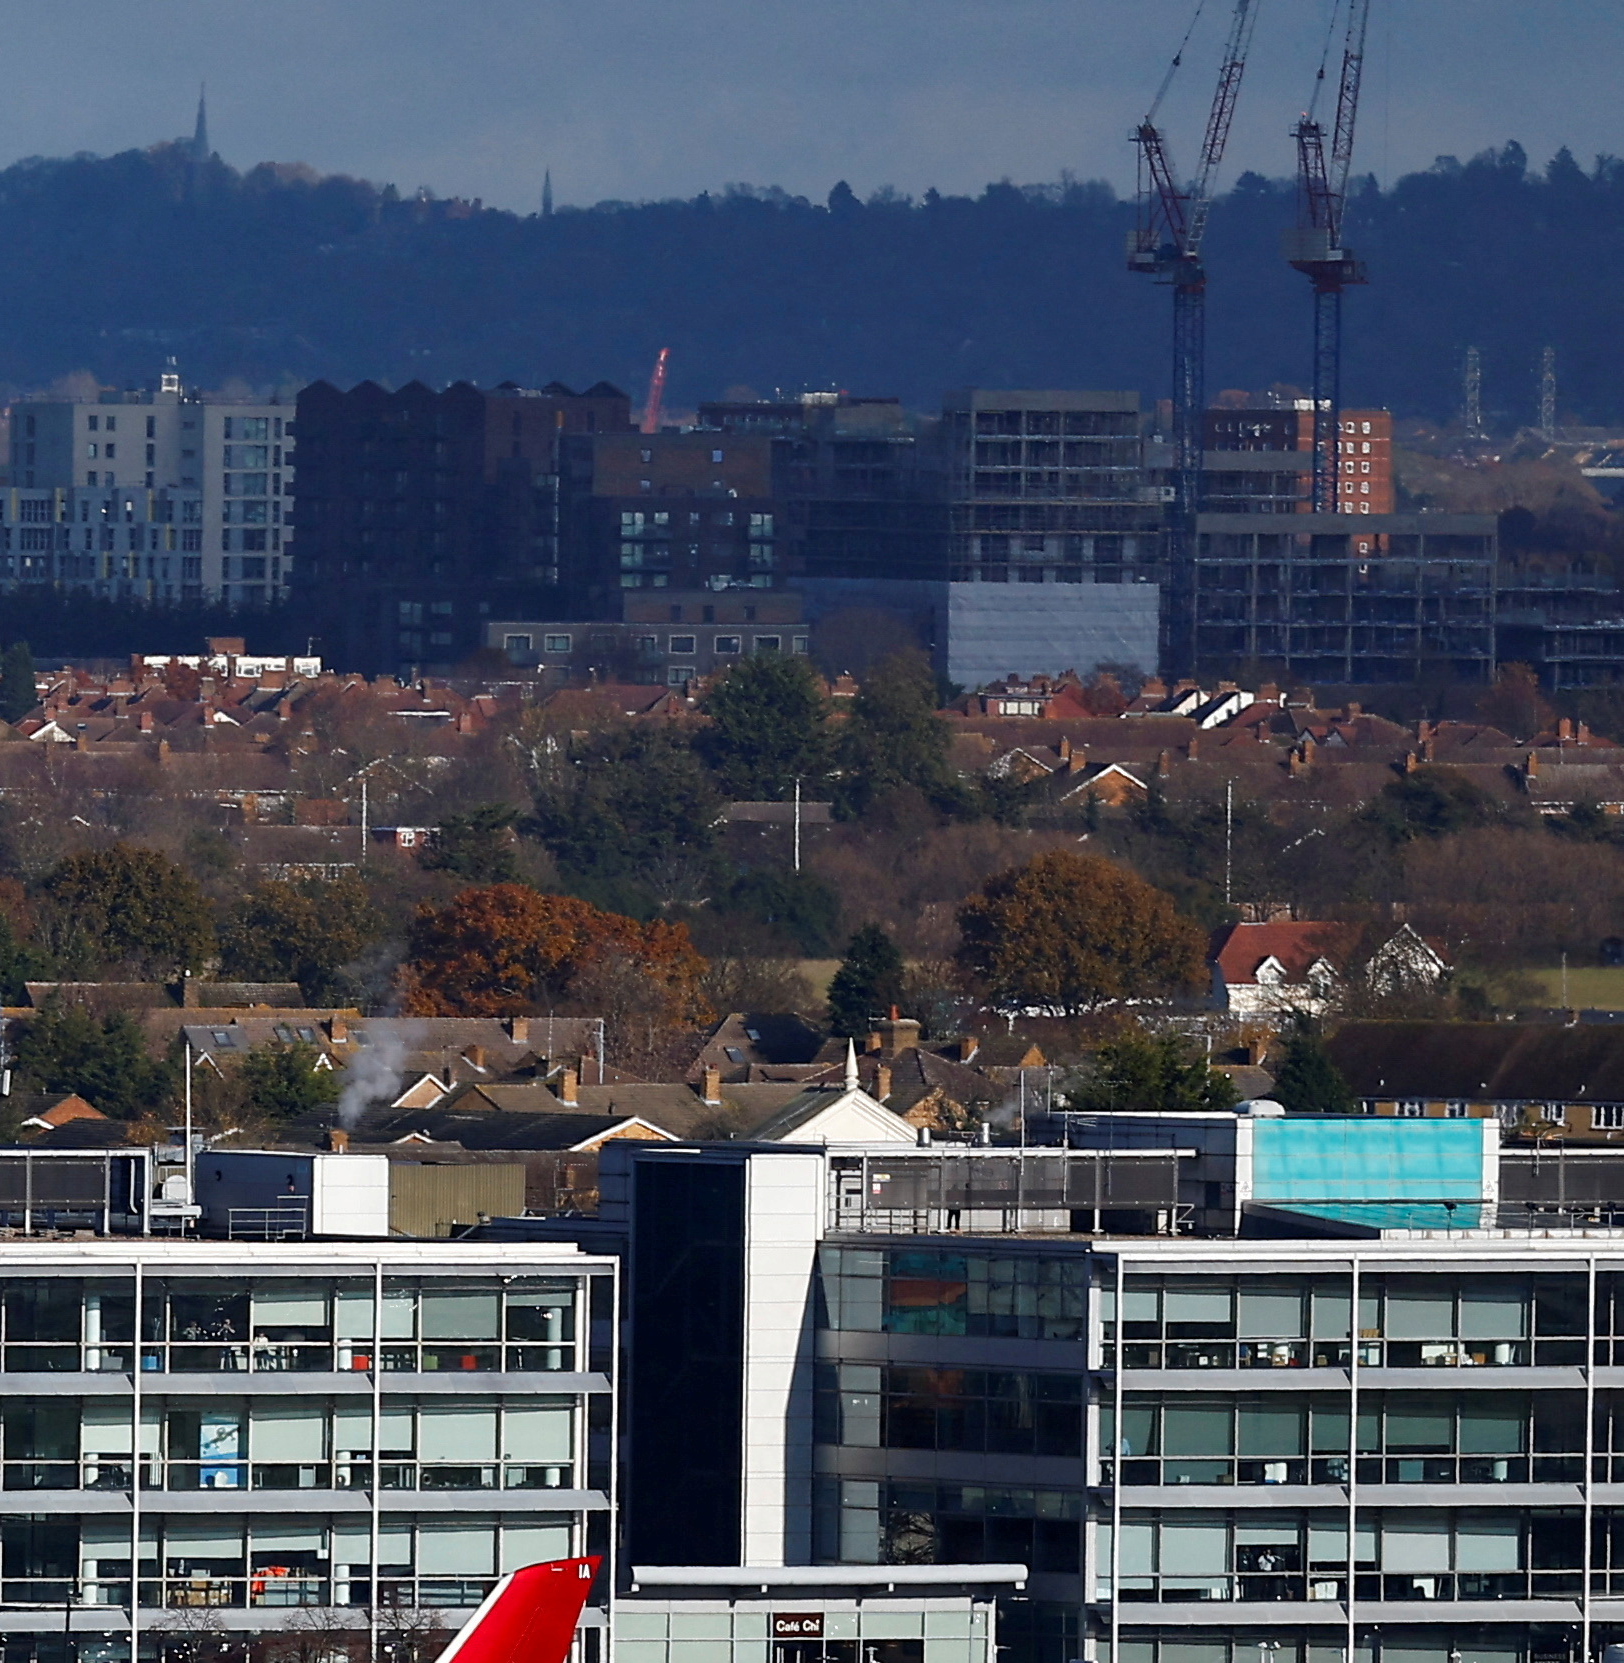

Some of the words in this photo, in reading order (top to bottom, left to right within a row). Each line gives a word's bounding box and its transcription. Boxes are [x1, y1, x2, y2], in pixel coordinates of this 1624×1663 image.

[578, 1563, 591, 1579] IA
[776, 1620, 800, 1632] Café
[802, 1619, 820, 1632] Chi
